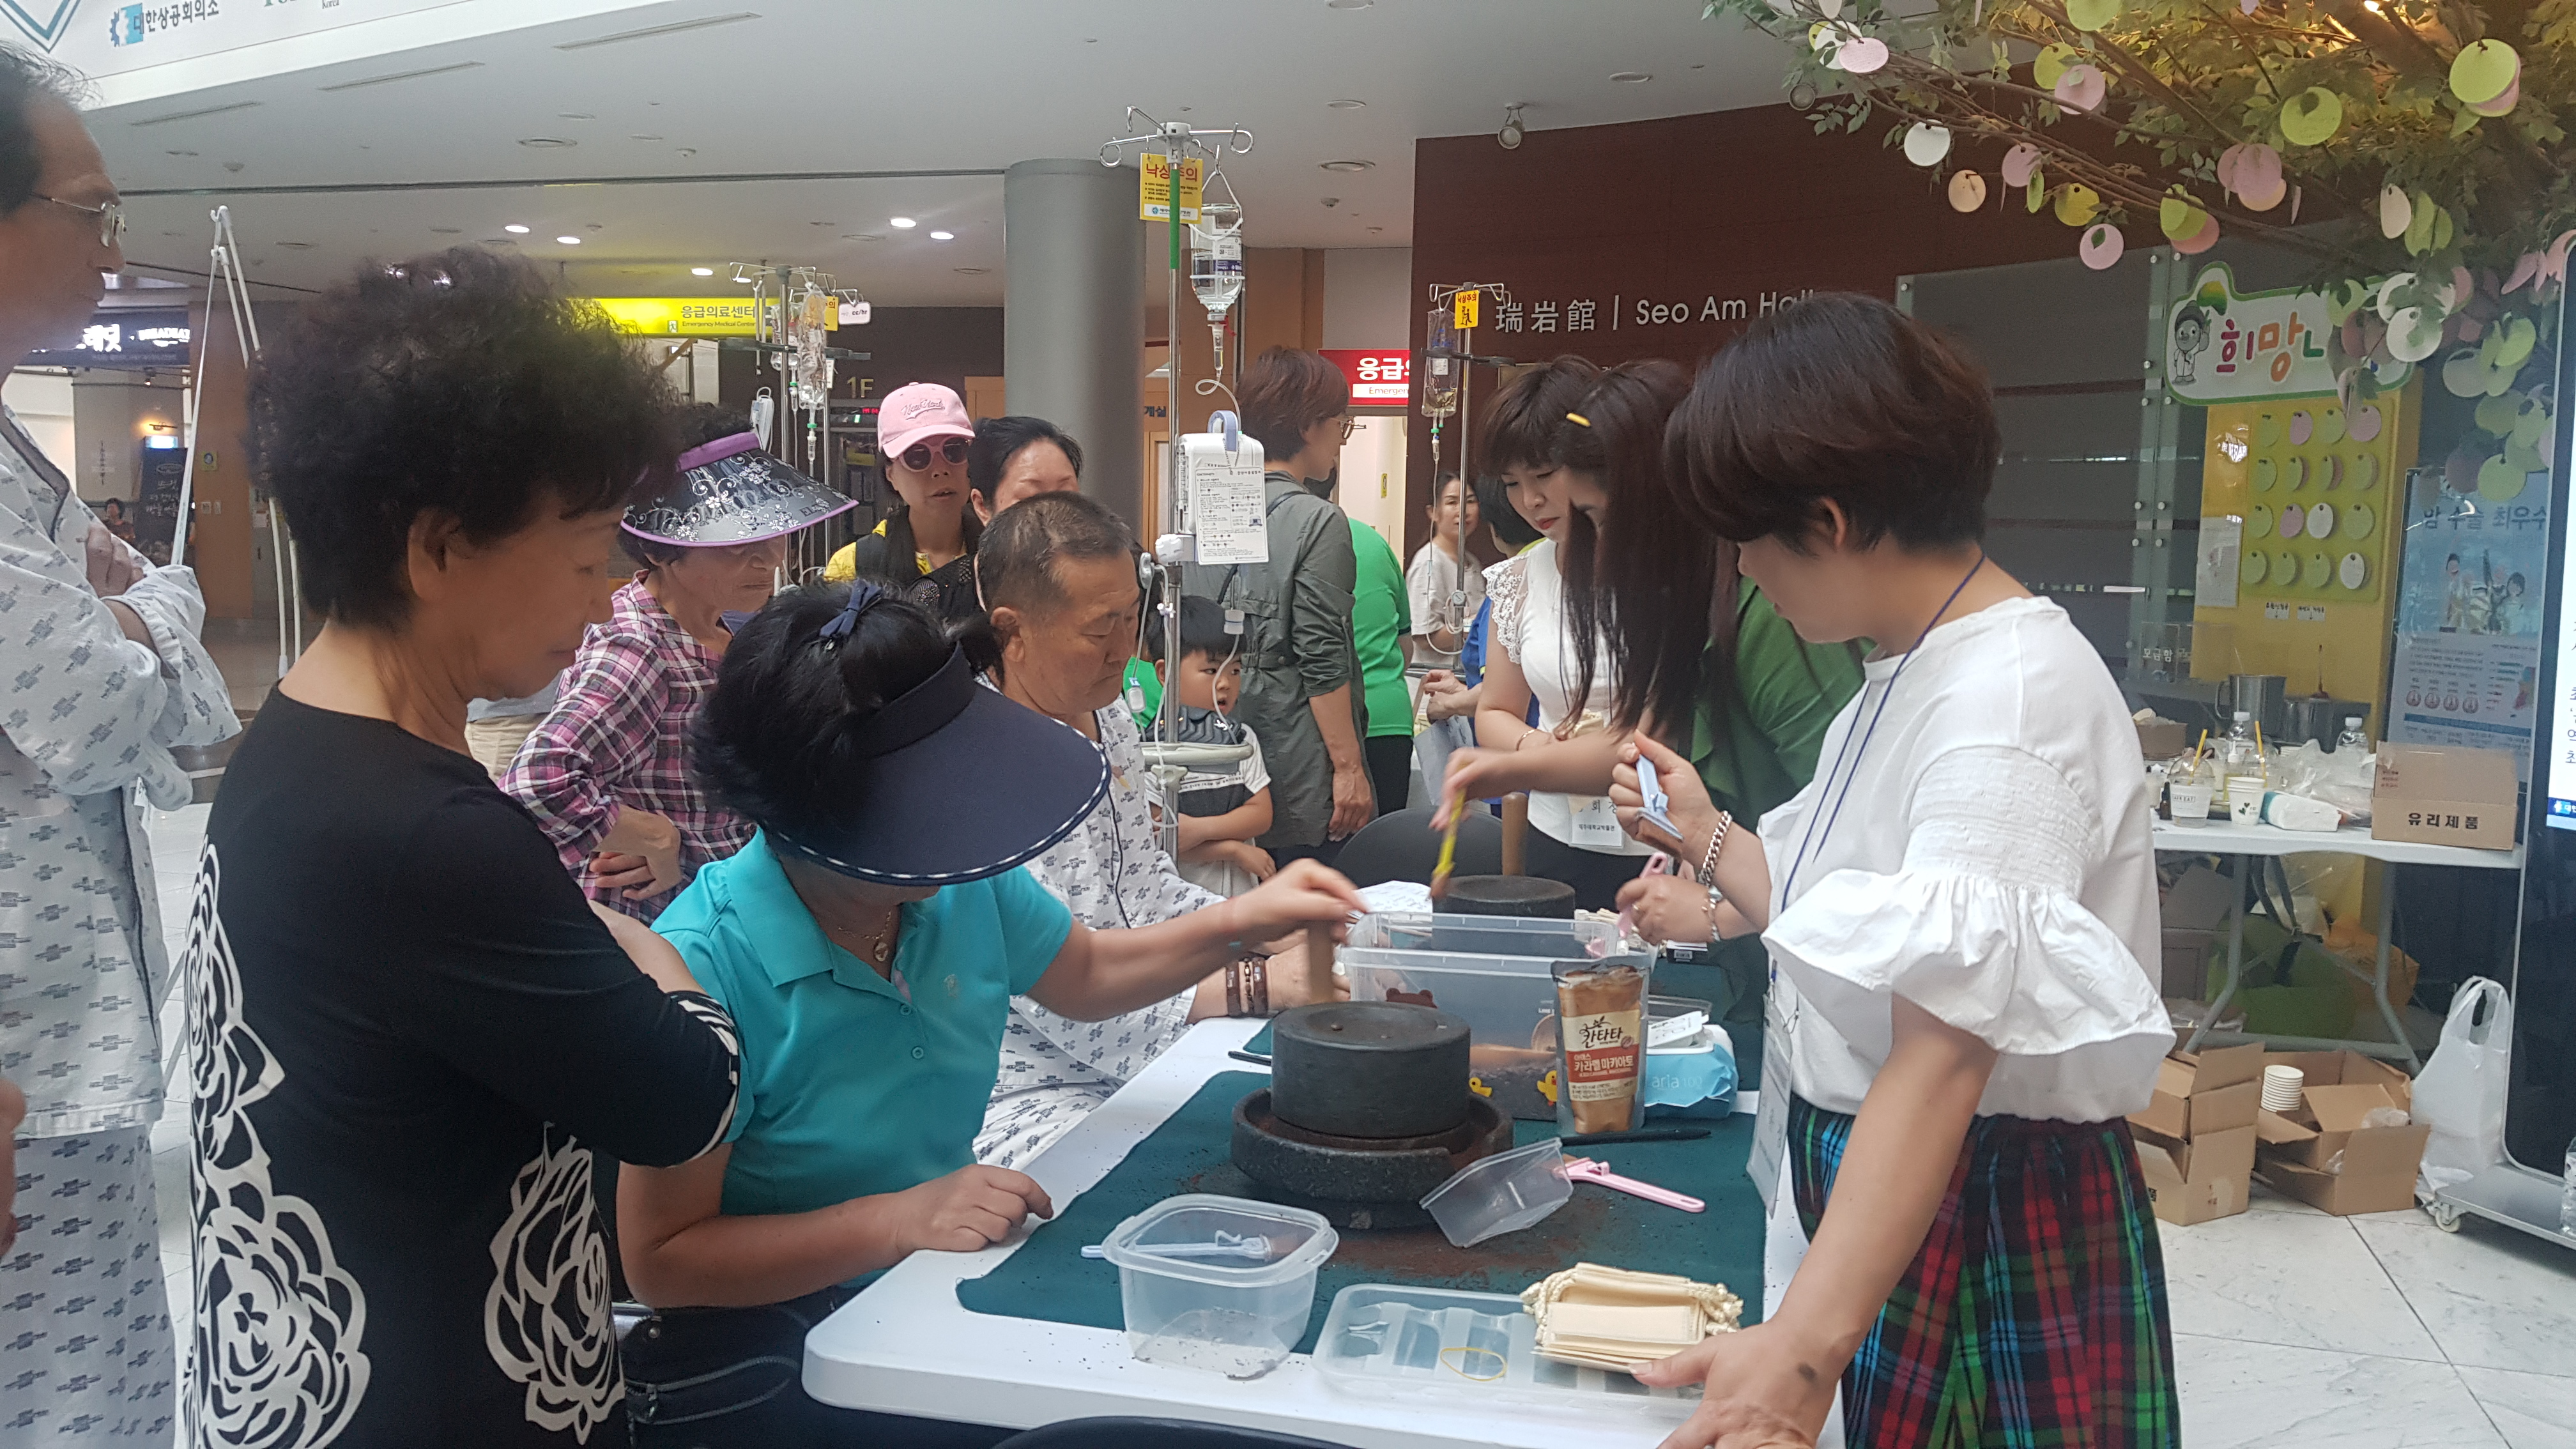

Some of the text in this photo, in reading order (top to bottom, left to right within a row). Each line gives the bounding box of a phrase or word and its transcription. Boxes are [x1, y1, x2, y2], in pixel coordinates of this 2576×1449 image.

[134, 0, 219, 34] 대한상공회의소
[681, 305, 755, 318] 응급의료센터
[1495, 300, 1596, 333] 瑞岩館
[1636, 299, 1689, 325] Seo
[1699, 296, 1746, 322] Am
[847, 376, 874, 398] 1F
[2143, 648, 2173, 663] 모금함
[2409, 812, 2478, 830] 유리제품
[1579, 1023, 1623, 1048] 칸타타
